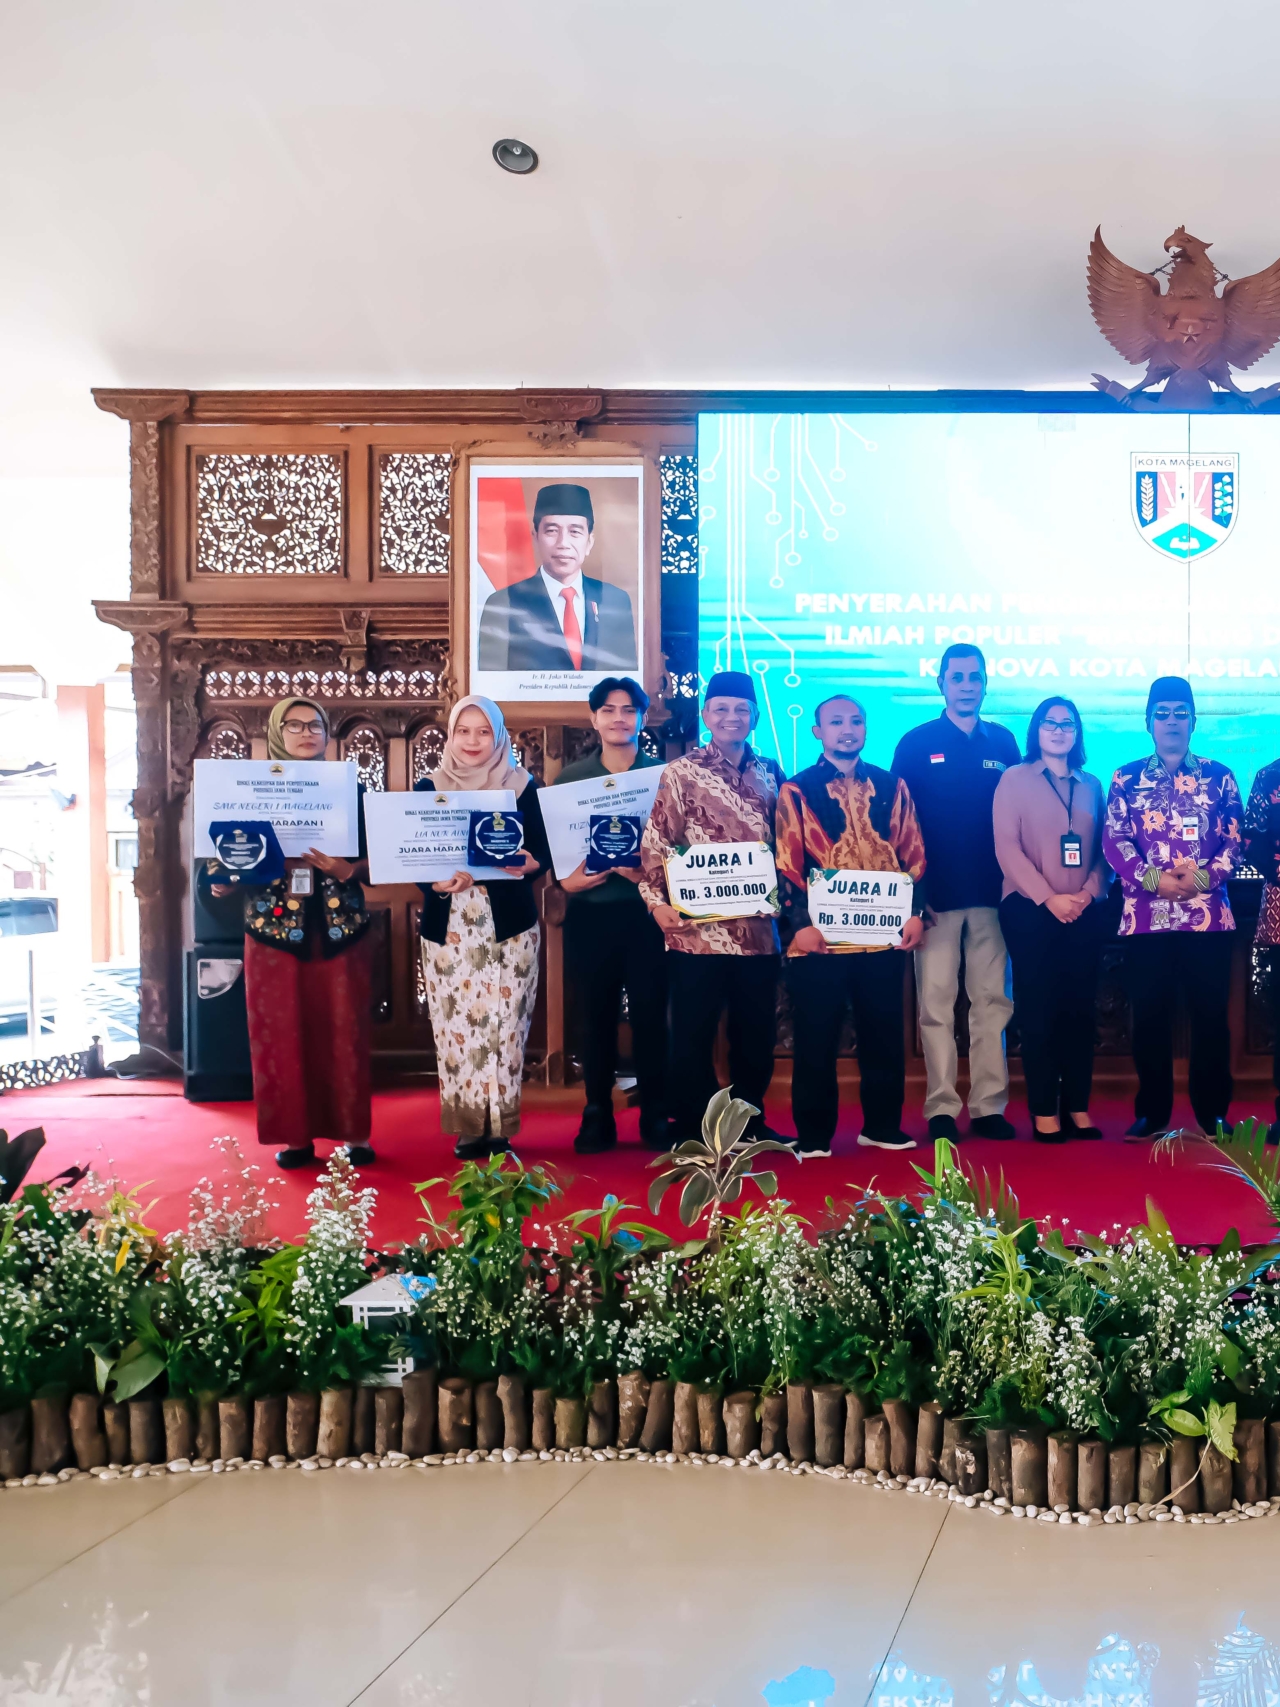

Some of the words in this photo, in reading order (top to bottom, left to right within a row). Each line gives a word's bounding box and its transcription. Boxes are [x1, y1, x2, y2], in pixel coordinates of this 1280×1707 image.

[1170, 459, 1232, 467] MAGELANG
[795, 593, 991, 613] PENYERAHAN
[825, 625, 925, 645] ILMIAH
[935, 625, 1061, 646] POPULER
[1069, 658, 1148, 678] KOTA
[280, 802, 333, 811] MAGELANG
[399, 846, 431, 854] JUARA
[686, 853, 742, 869] JUARA
[748, 852, 753, 866] I
[680, 887, 700, 901] Rp.
[704, 882, 767, 899] 3.000.000
[827, 880, 882, 896] JUARA
[888, 883, 898, 897] II
[818, 912, 837, 926] Rp.
[841, 912, 902, 927] 3.000.000
